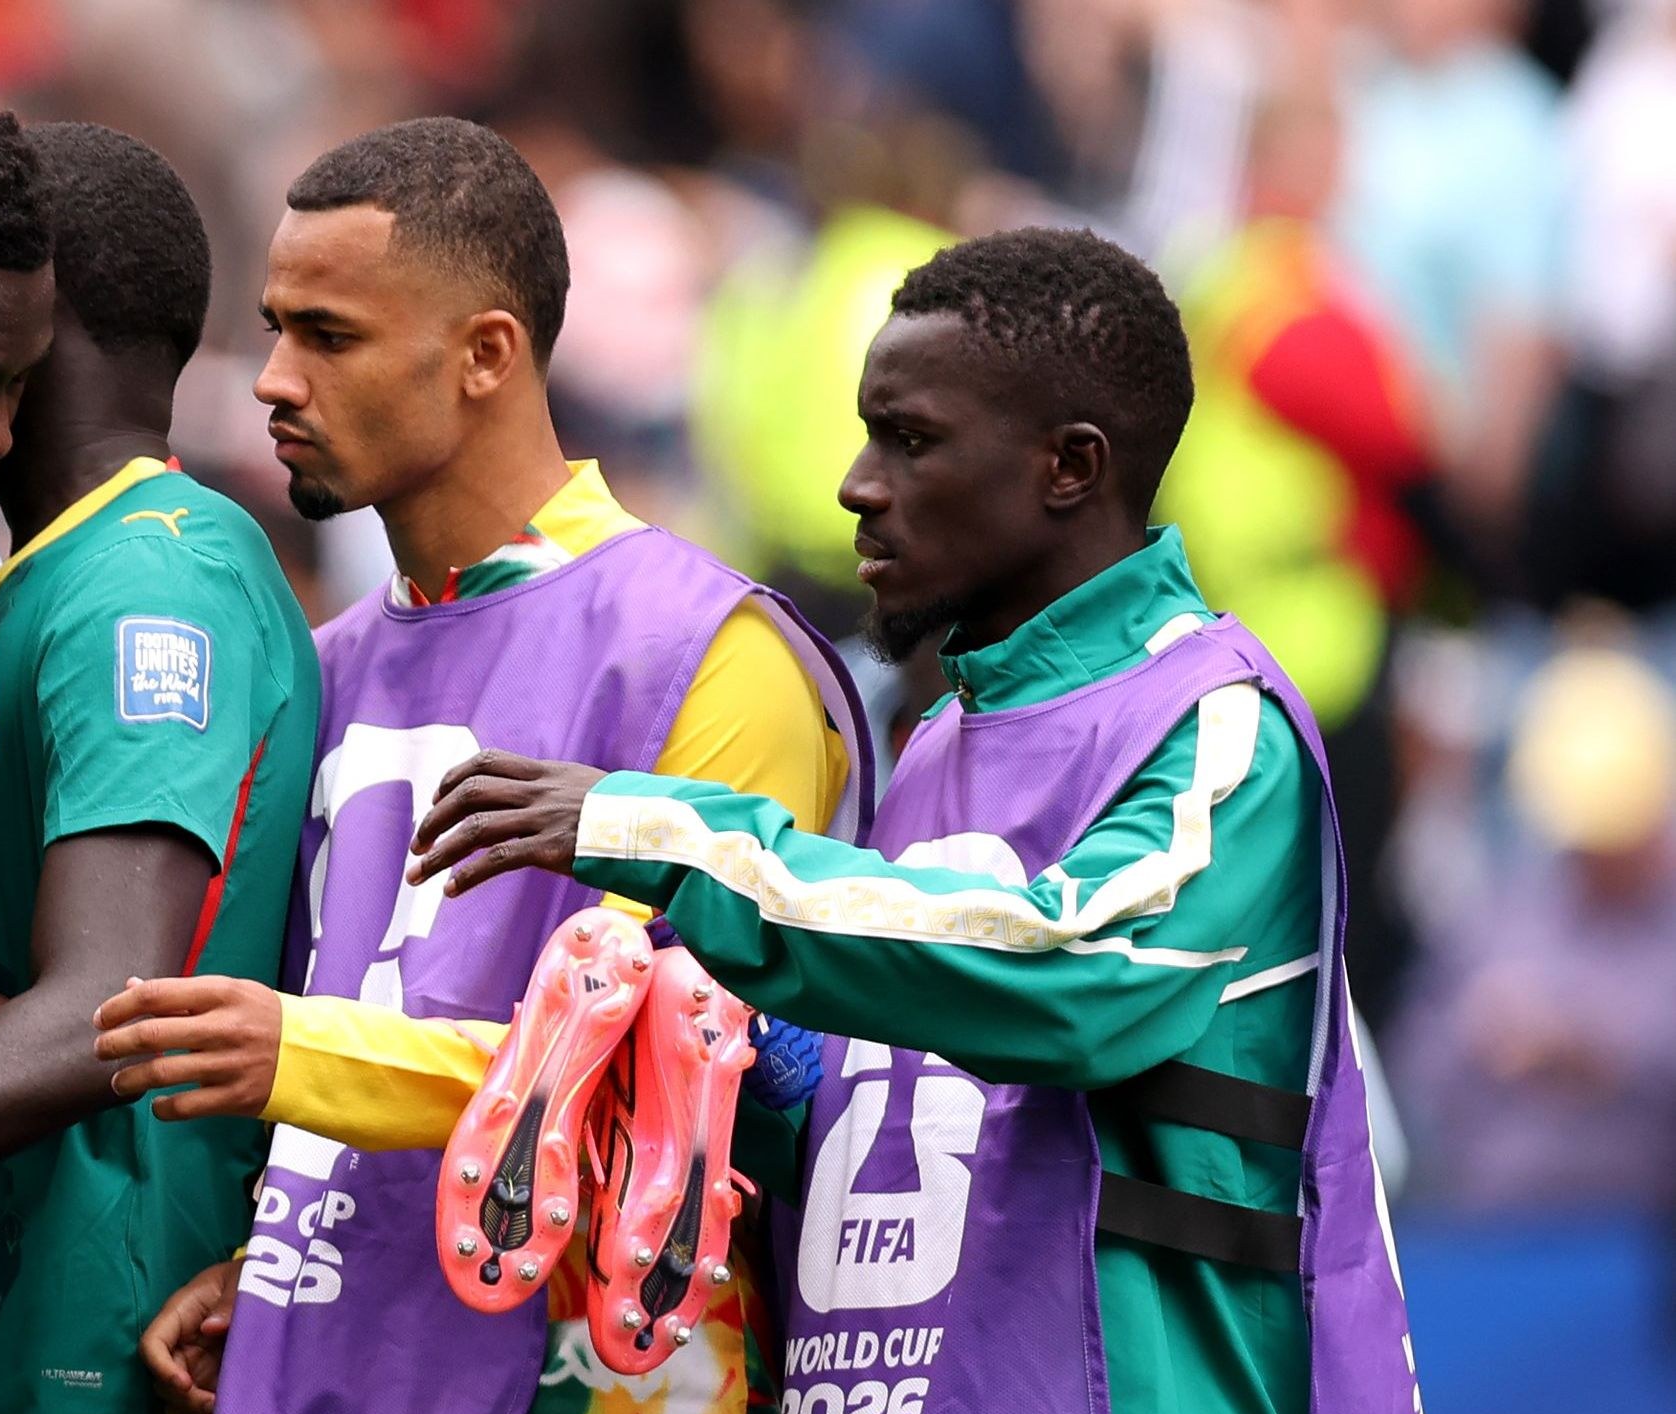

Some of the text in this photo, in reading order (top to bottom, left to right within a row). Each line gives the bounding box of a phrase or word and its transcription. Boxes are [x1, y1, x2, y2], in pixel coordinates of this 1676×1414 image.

[135, 632, 198, 658] FOOTBALL
[135, 648, 199, 680] UNITES
[131, 671, 200, 702] the World
[836, 1217, 916, 1266] FIFA
[784, 1327, 944, 1378] WORLD CUP
